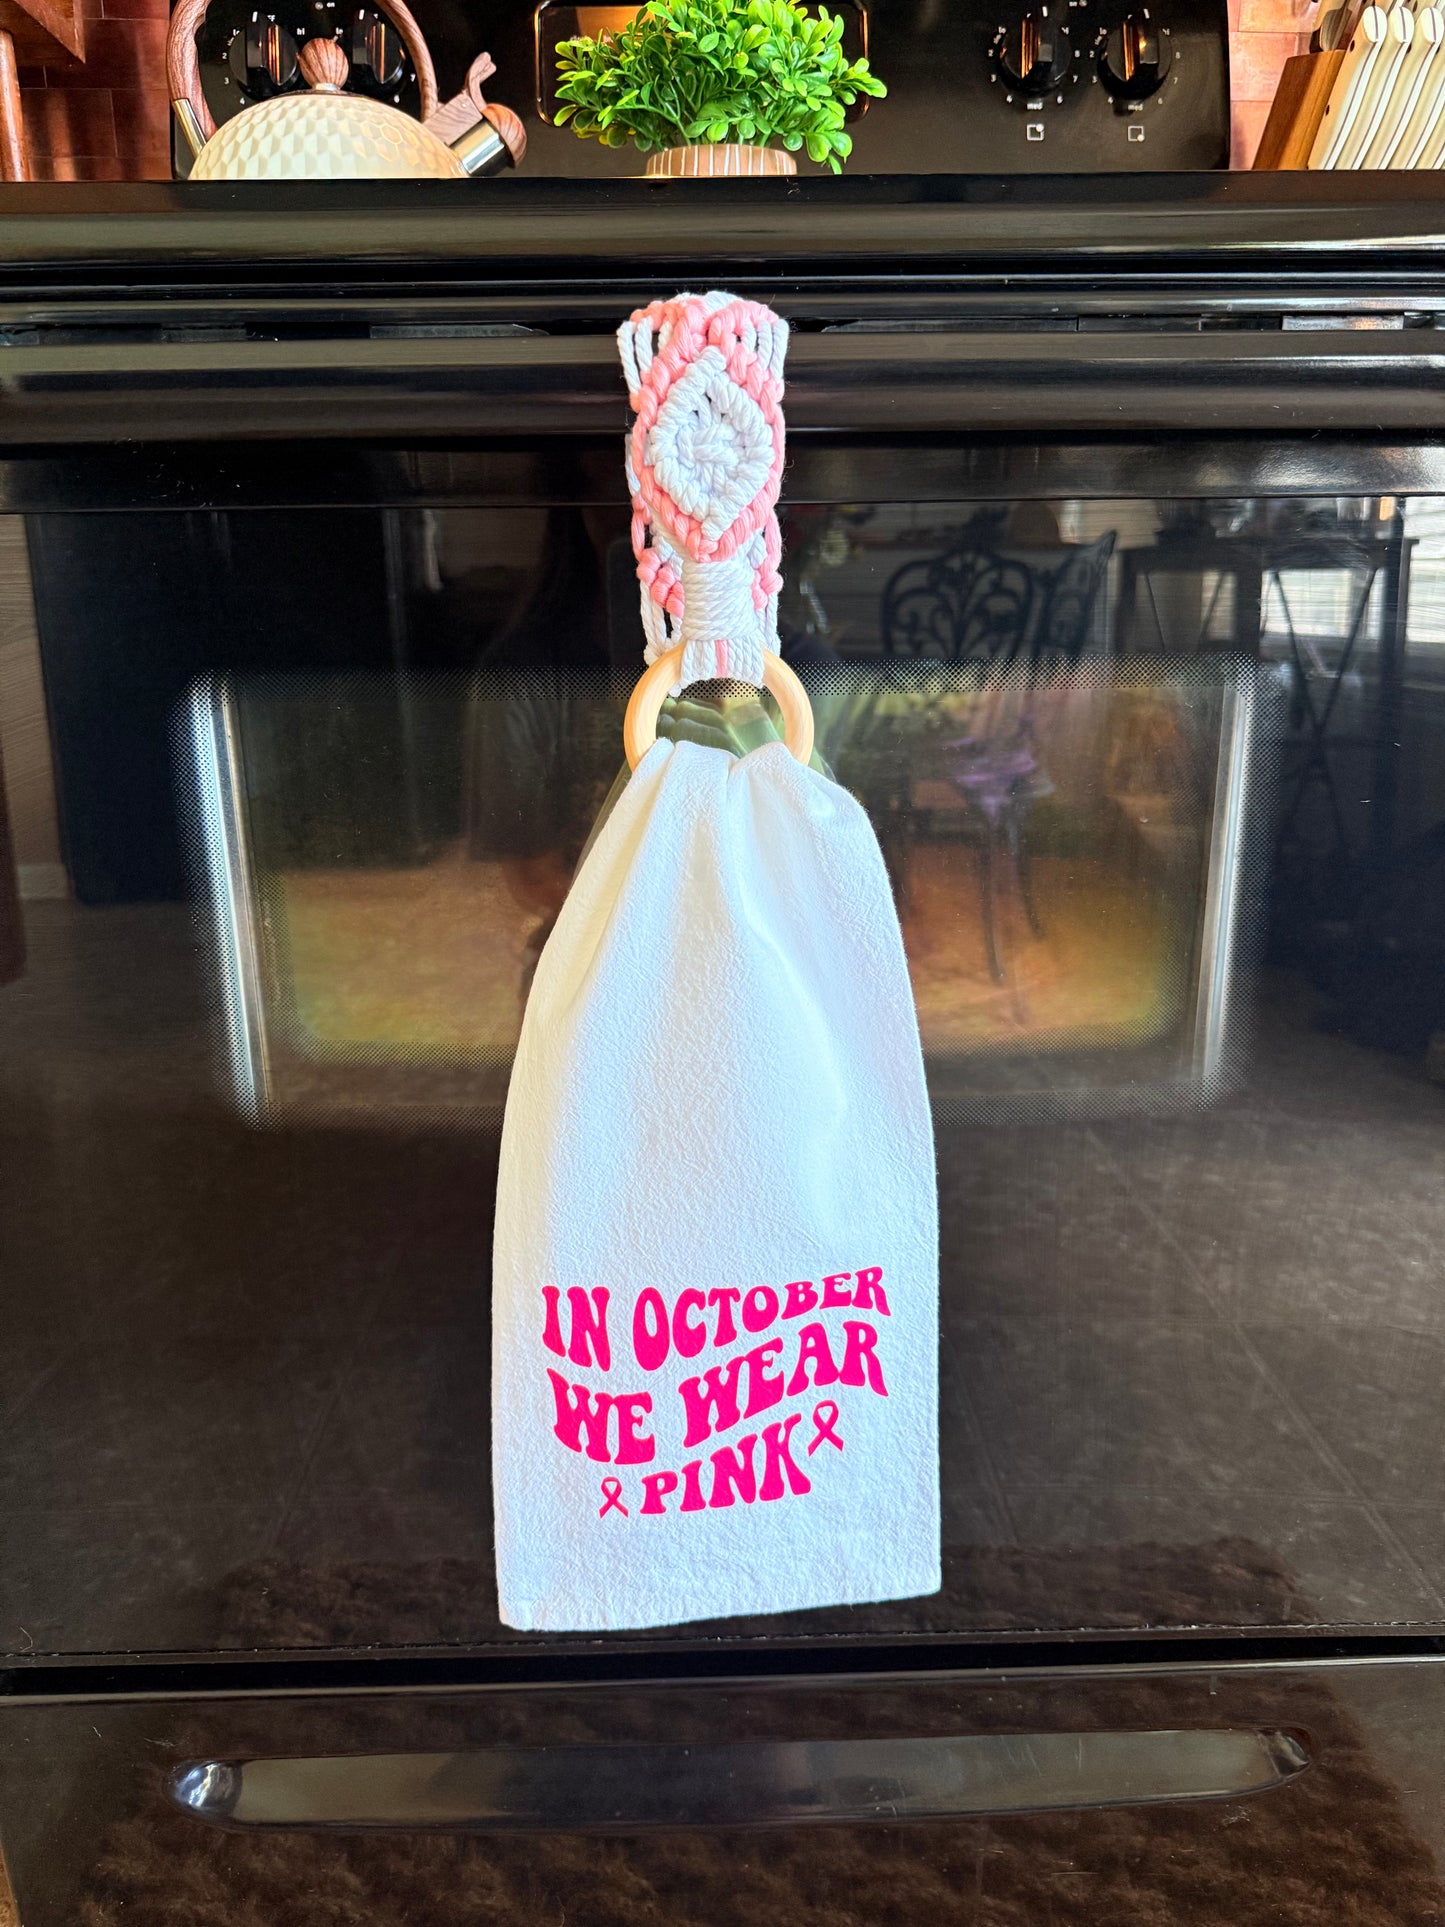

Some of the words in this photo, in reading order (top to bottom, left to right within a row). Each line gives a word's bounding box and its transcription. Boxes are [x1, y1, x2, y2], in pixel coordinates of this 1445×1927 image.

[542, 1285, 611, 1371] IN
[633, 1266, 891, 1371] OCTOBER
[547, 1368, 655, 1465] WE
[678, 1320, 889, 1448] WEAR
[640, 1413, 811, 1515] PINK
